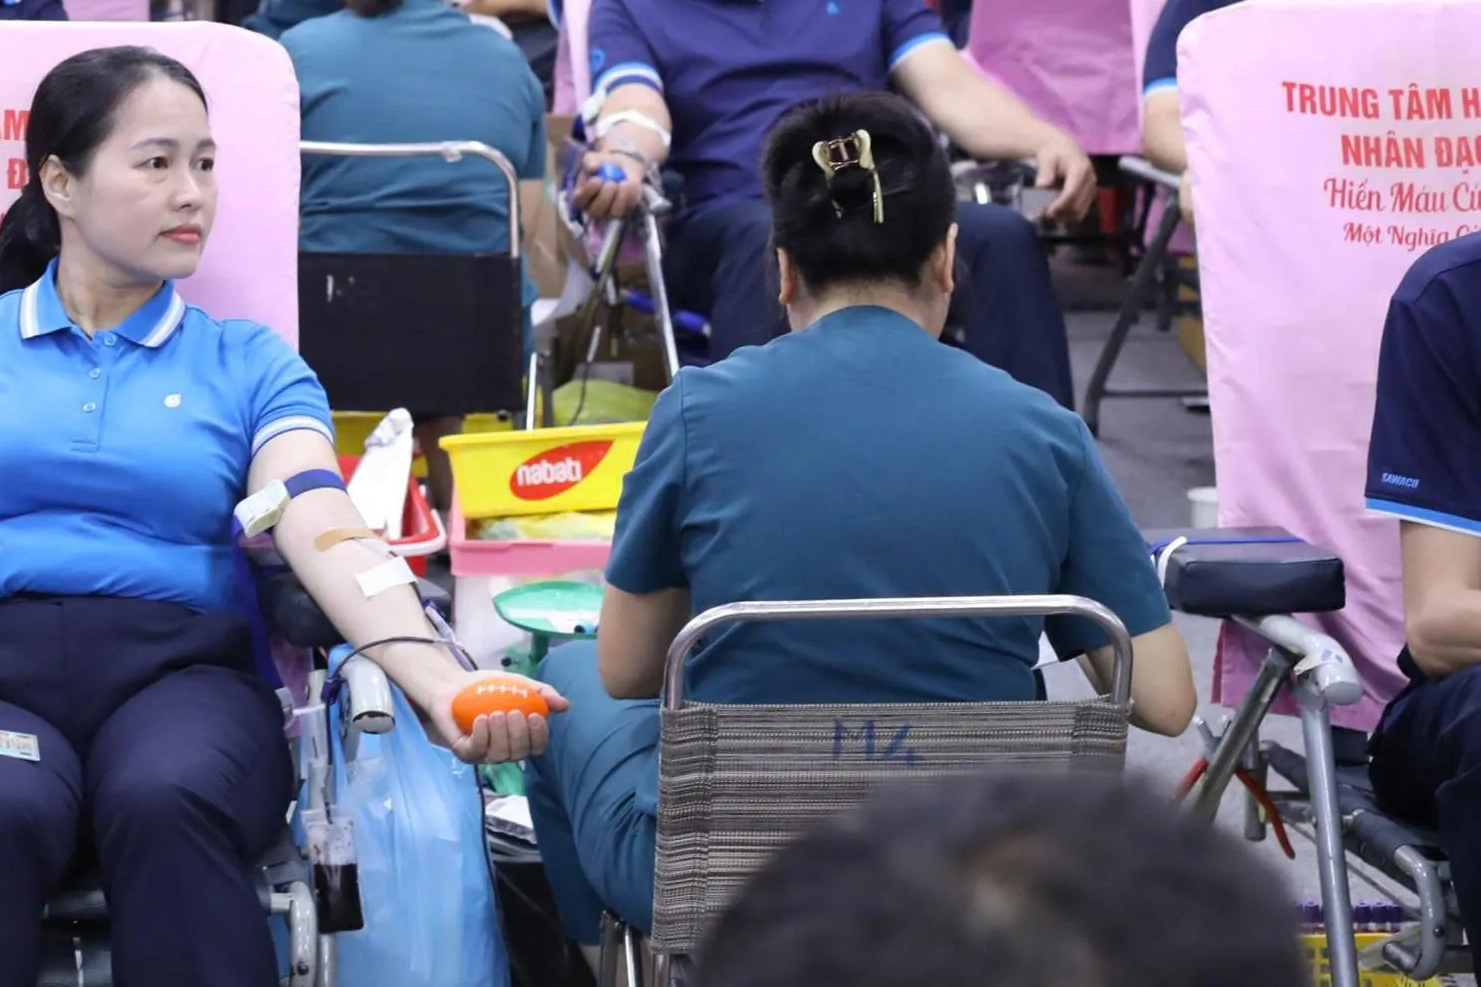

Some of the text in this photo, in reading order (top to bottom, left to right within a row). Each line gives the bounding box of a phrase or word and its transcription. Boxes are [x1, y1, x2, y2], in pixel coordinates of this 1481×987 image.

[1282, 81, 1380, 120] TRUNG
[1388, 82, 1453, 121] TÂM
[1341, 130, 1425, 169] NHÂN
[1323, 176, 1385, 212] Hiến
[1390, 181, 1449, 213] Máu
[1343, 221, 1383, 247] Một
[516, 457, 582, 487] nabati
[1381, 472, 1420, 489] SAWACO
